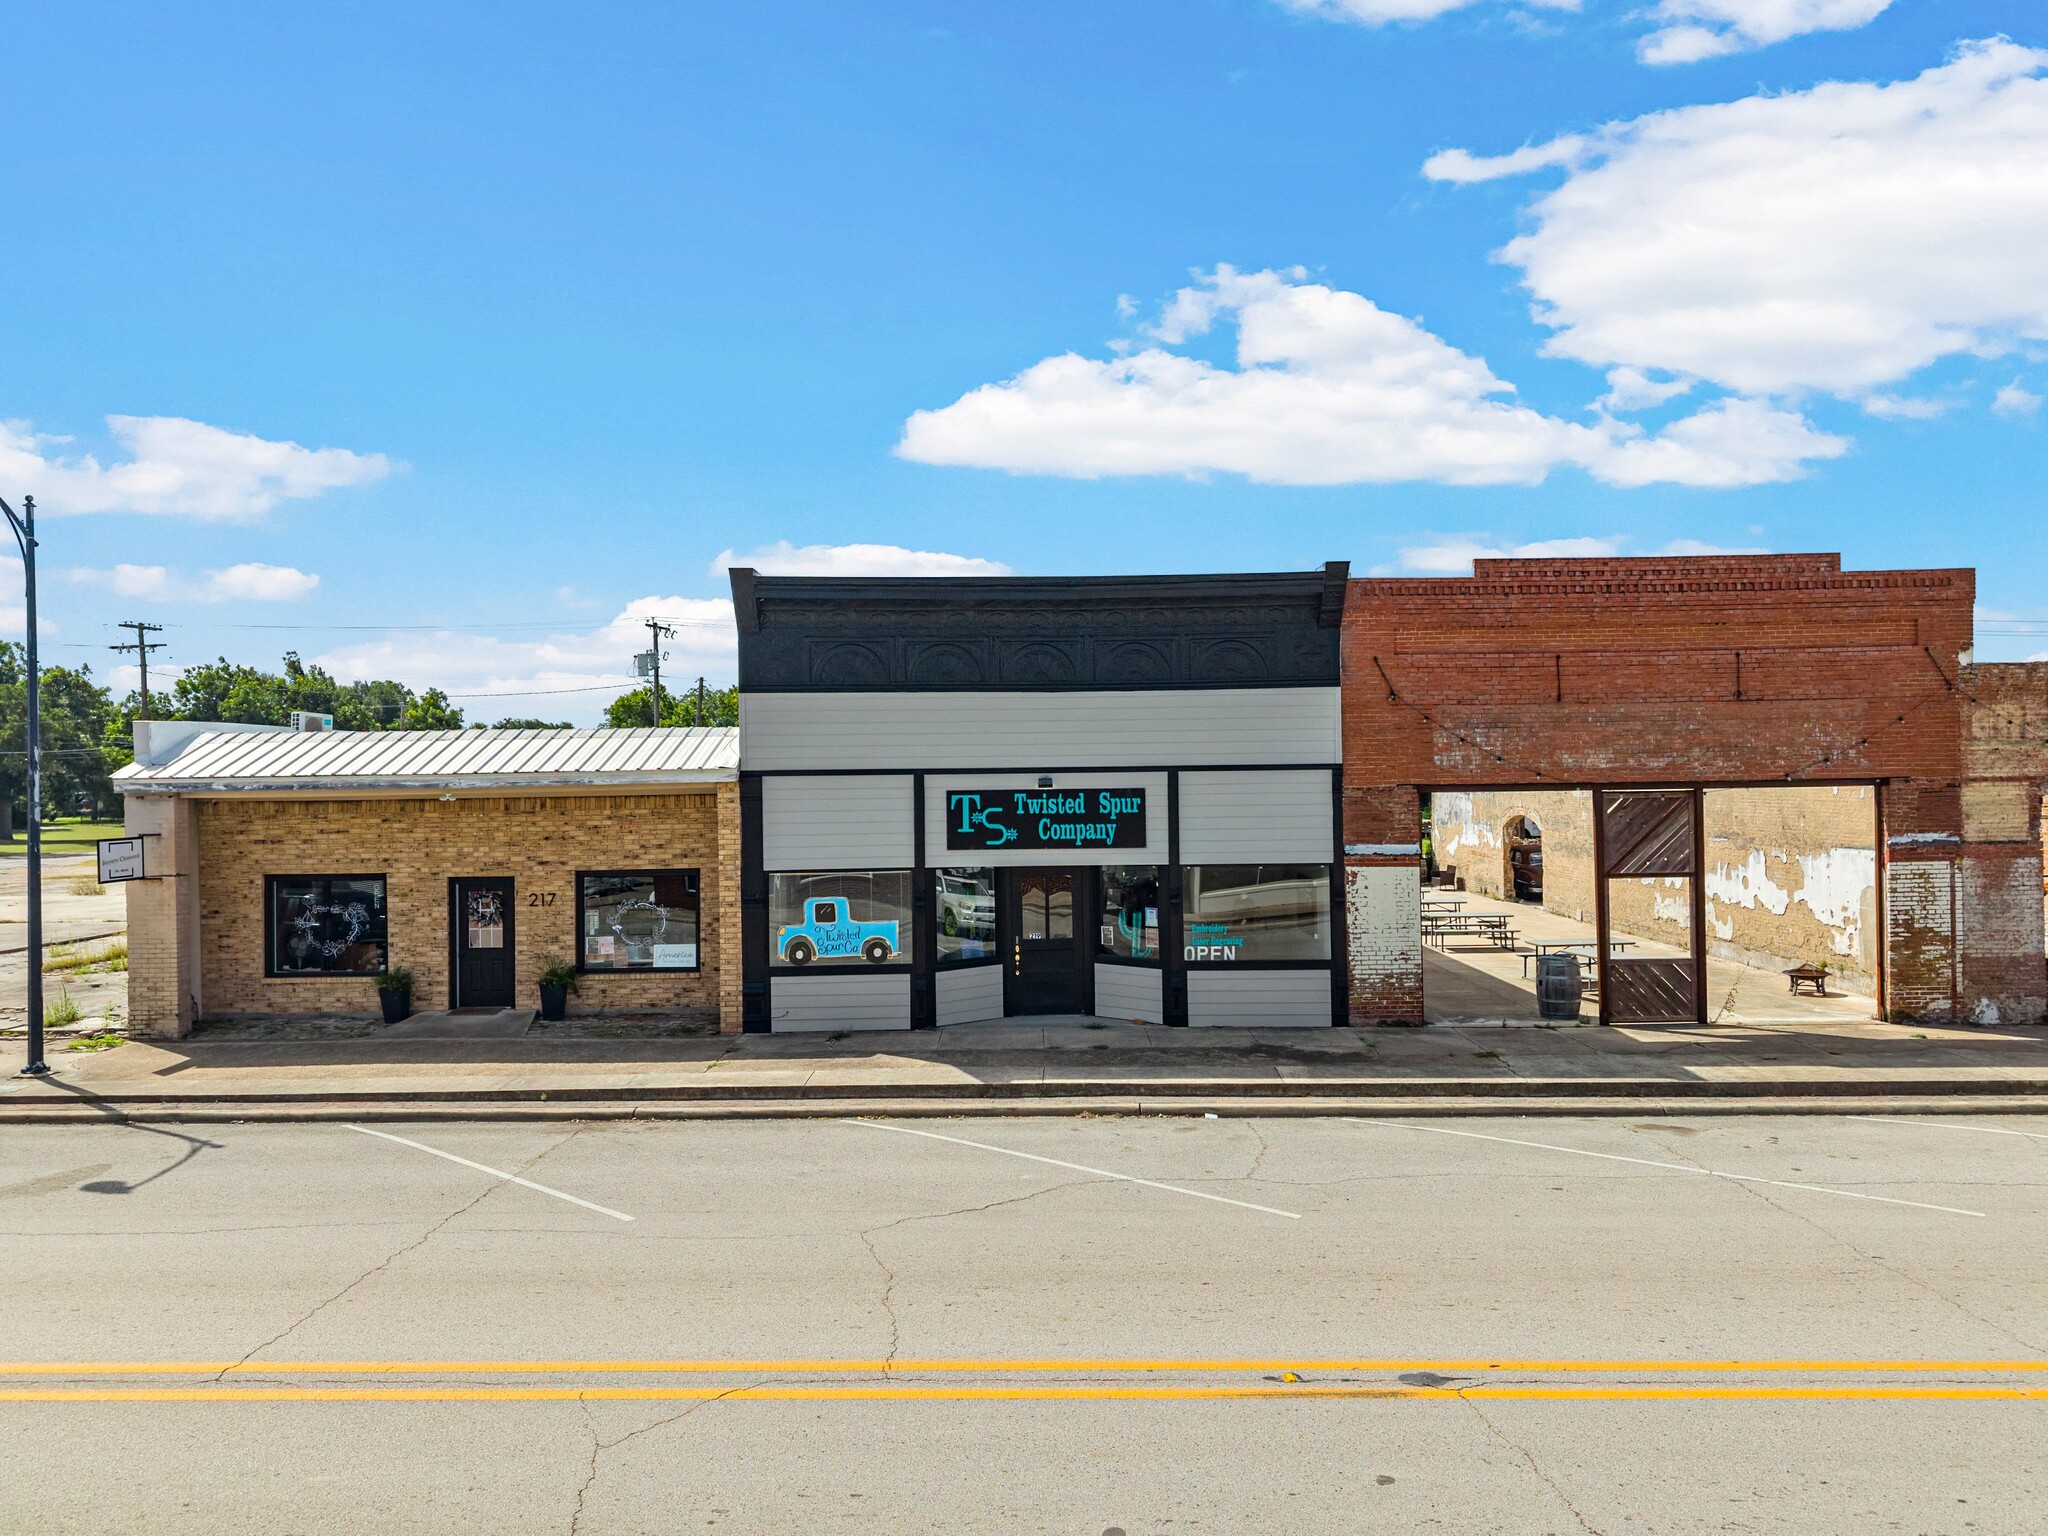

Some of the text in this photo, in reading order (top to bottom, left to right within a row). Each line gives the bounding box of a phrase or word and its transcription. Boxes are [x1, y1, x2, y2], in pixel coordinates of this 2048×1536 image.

[1014, 792, 1141, 819] Twisted Spur
[1038, 818, 1117, 846] Company
[528, 892, 557, 907] 217
[814, 924, 861, 942] Twisted
[658, 948, 695, 961] America
[817, 937, 859, 955] Spur Co
[1183, 945, 1236, 961] OPEN
